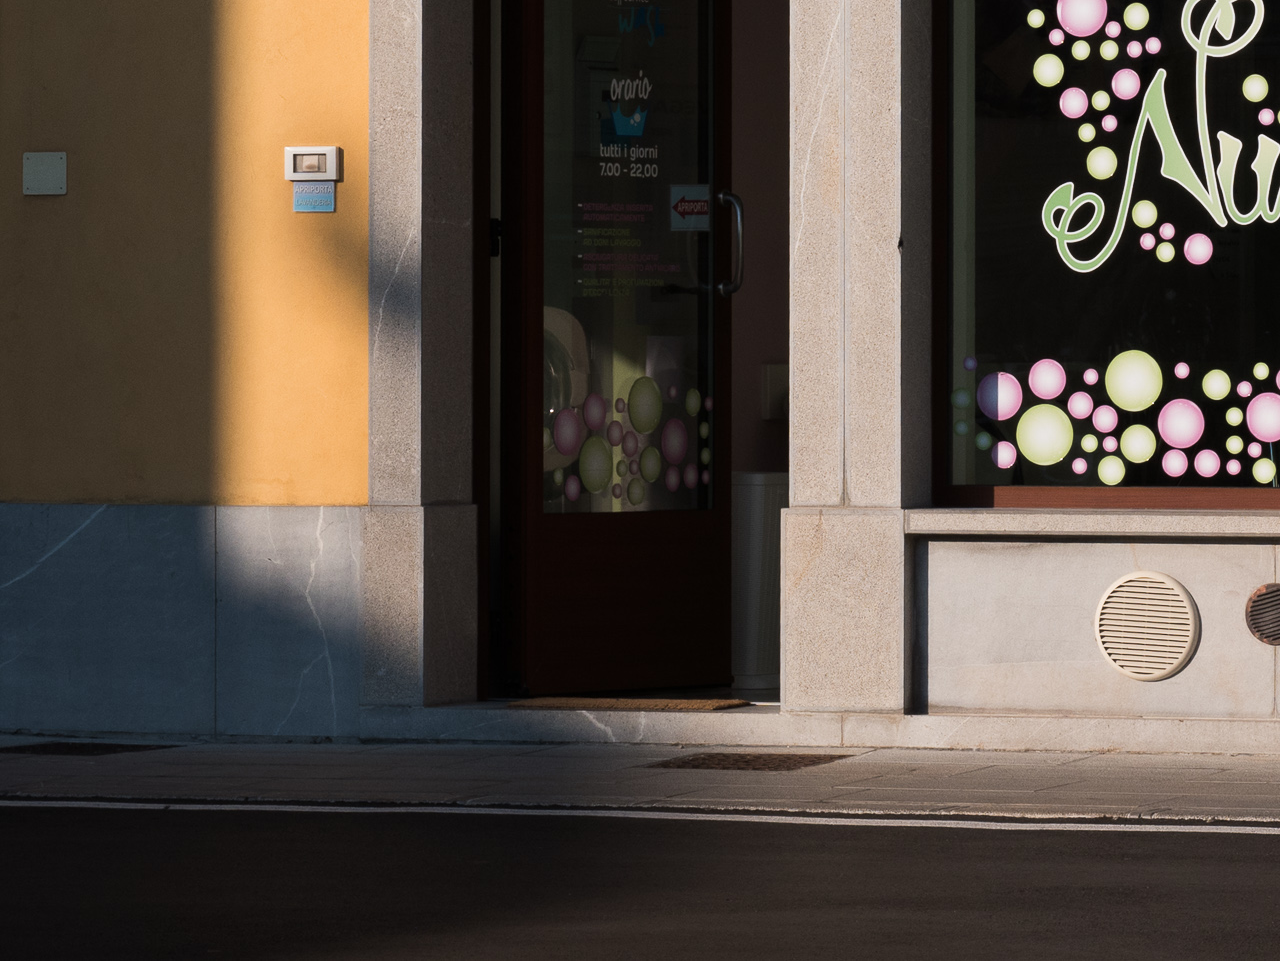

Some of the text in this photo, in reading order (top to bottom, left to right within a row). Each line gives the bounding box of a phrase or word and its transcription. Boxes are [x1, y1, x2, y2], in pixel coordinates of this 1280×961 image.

[610, 70, 653, 101] orario
[600, 143, 658, 161] tutti i giorni
[599, 163, 621, 177] 7.00
[295, 185, 333, 194] APRIPORTA
[296, 199, 332, 207] LAVANDERIA
[677, 202, 708, 212] APRIPORTA
